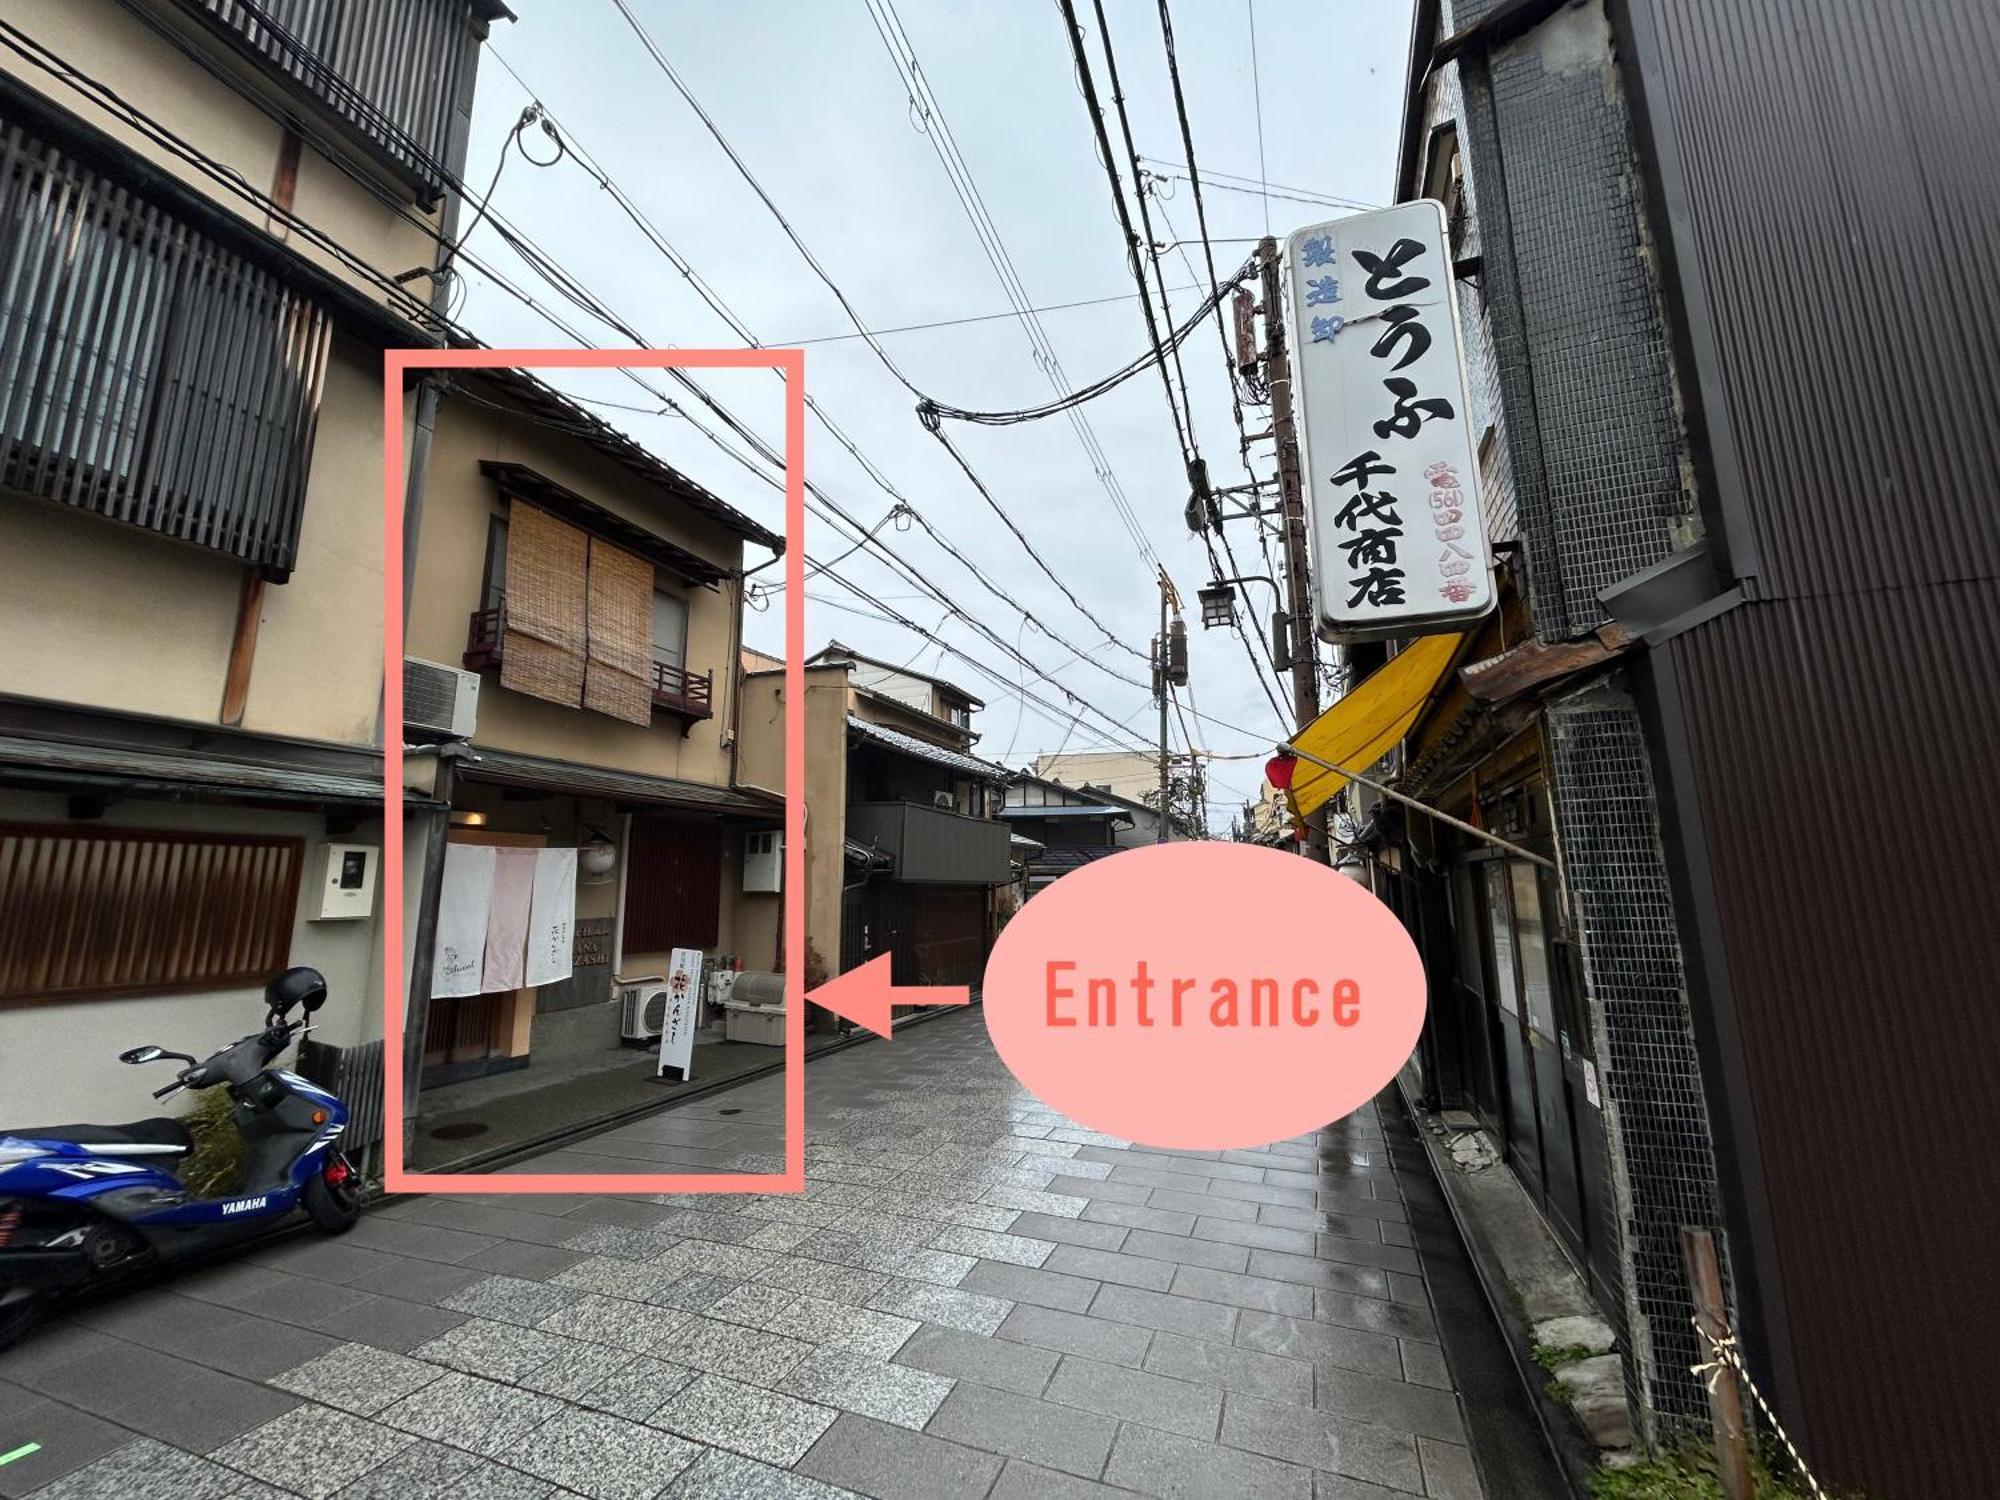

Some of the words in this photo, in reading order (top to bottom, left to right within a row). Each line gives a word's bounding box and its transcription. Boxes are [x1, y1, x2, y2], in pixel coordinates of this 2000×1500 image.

[1301, 235, 1345, 343] 製造卸
[1352, 238, 1455, 440] とうふ
[1330, 450, 1406, 608] 千代商店
[222, 1197, 267, 1215] YAMAHA
